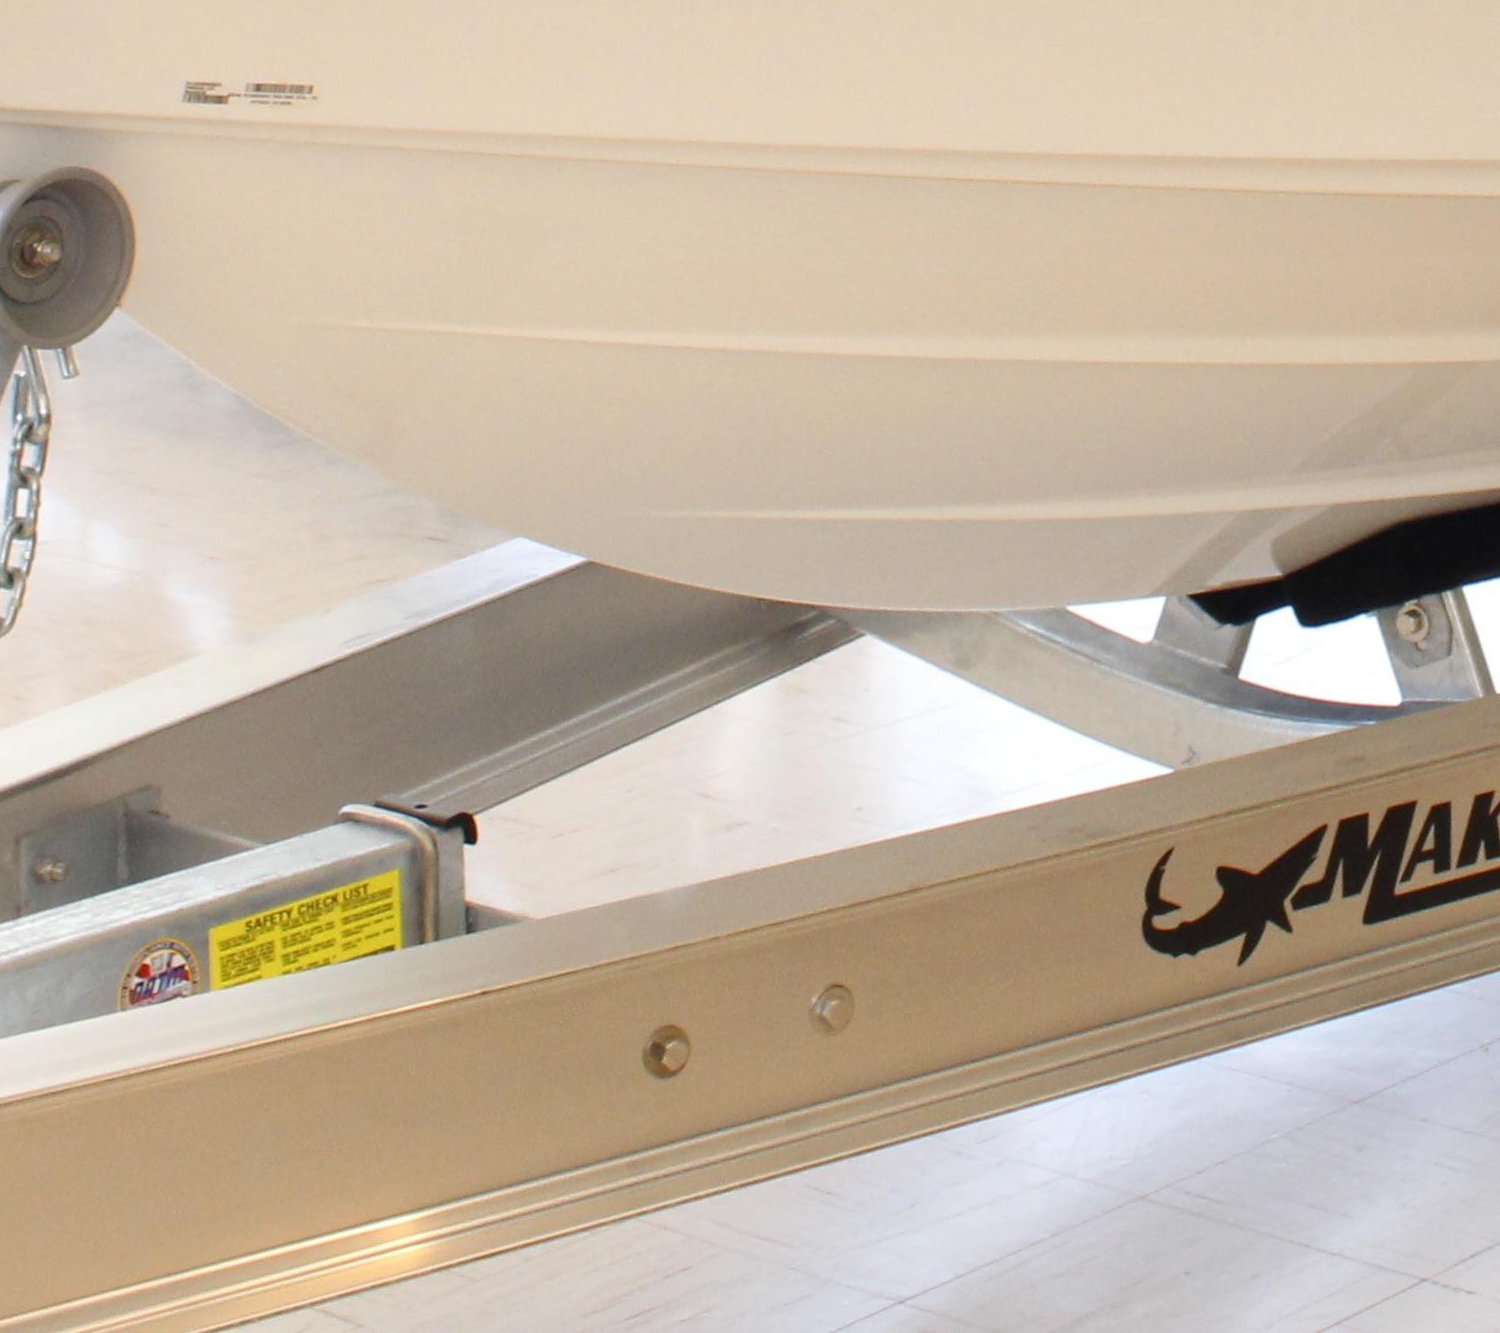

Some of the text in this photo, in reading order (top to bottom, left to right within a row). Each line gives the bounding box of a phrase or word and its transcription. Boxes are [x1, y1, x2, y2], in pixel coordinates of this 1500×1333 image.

[244, 882, 370, 932] SAFETY CHECK LIST
